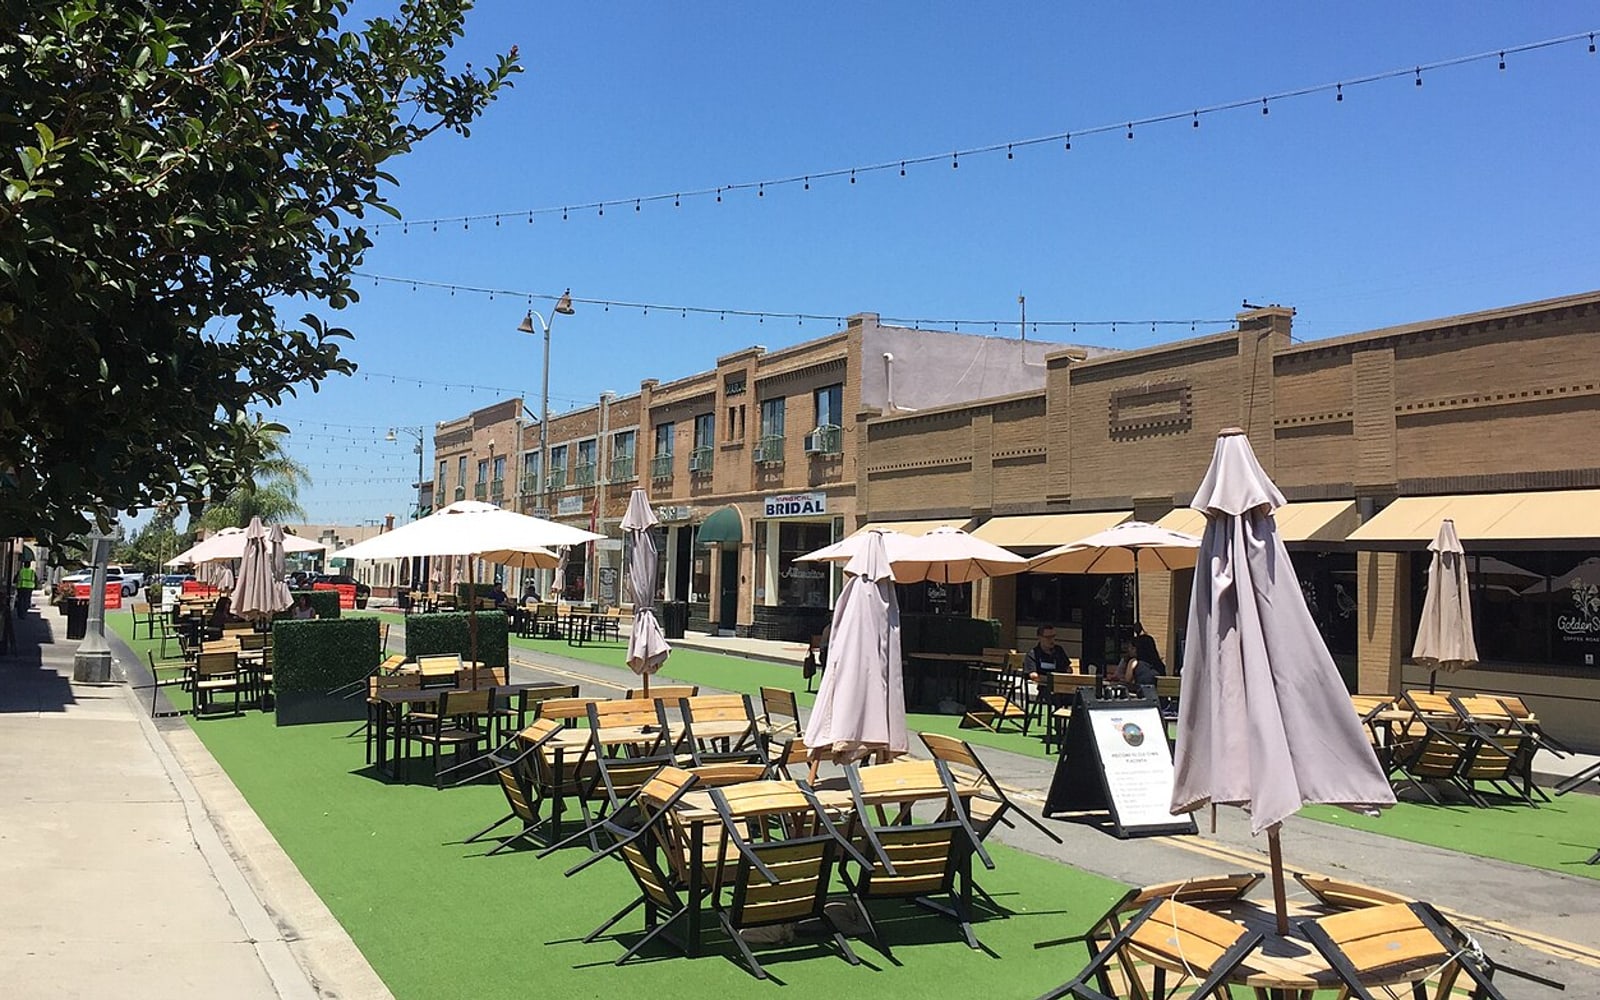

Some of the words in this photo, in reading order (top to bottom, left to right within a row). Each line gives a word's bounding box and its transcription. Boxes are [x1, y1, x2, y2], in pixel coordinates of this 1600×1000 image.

[766, 500, 824, 515] BRIDAL
[1557, 615, 1593, 633] Golden
[1592, 616, 1600, 631] S
